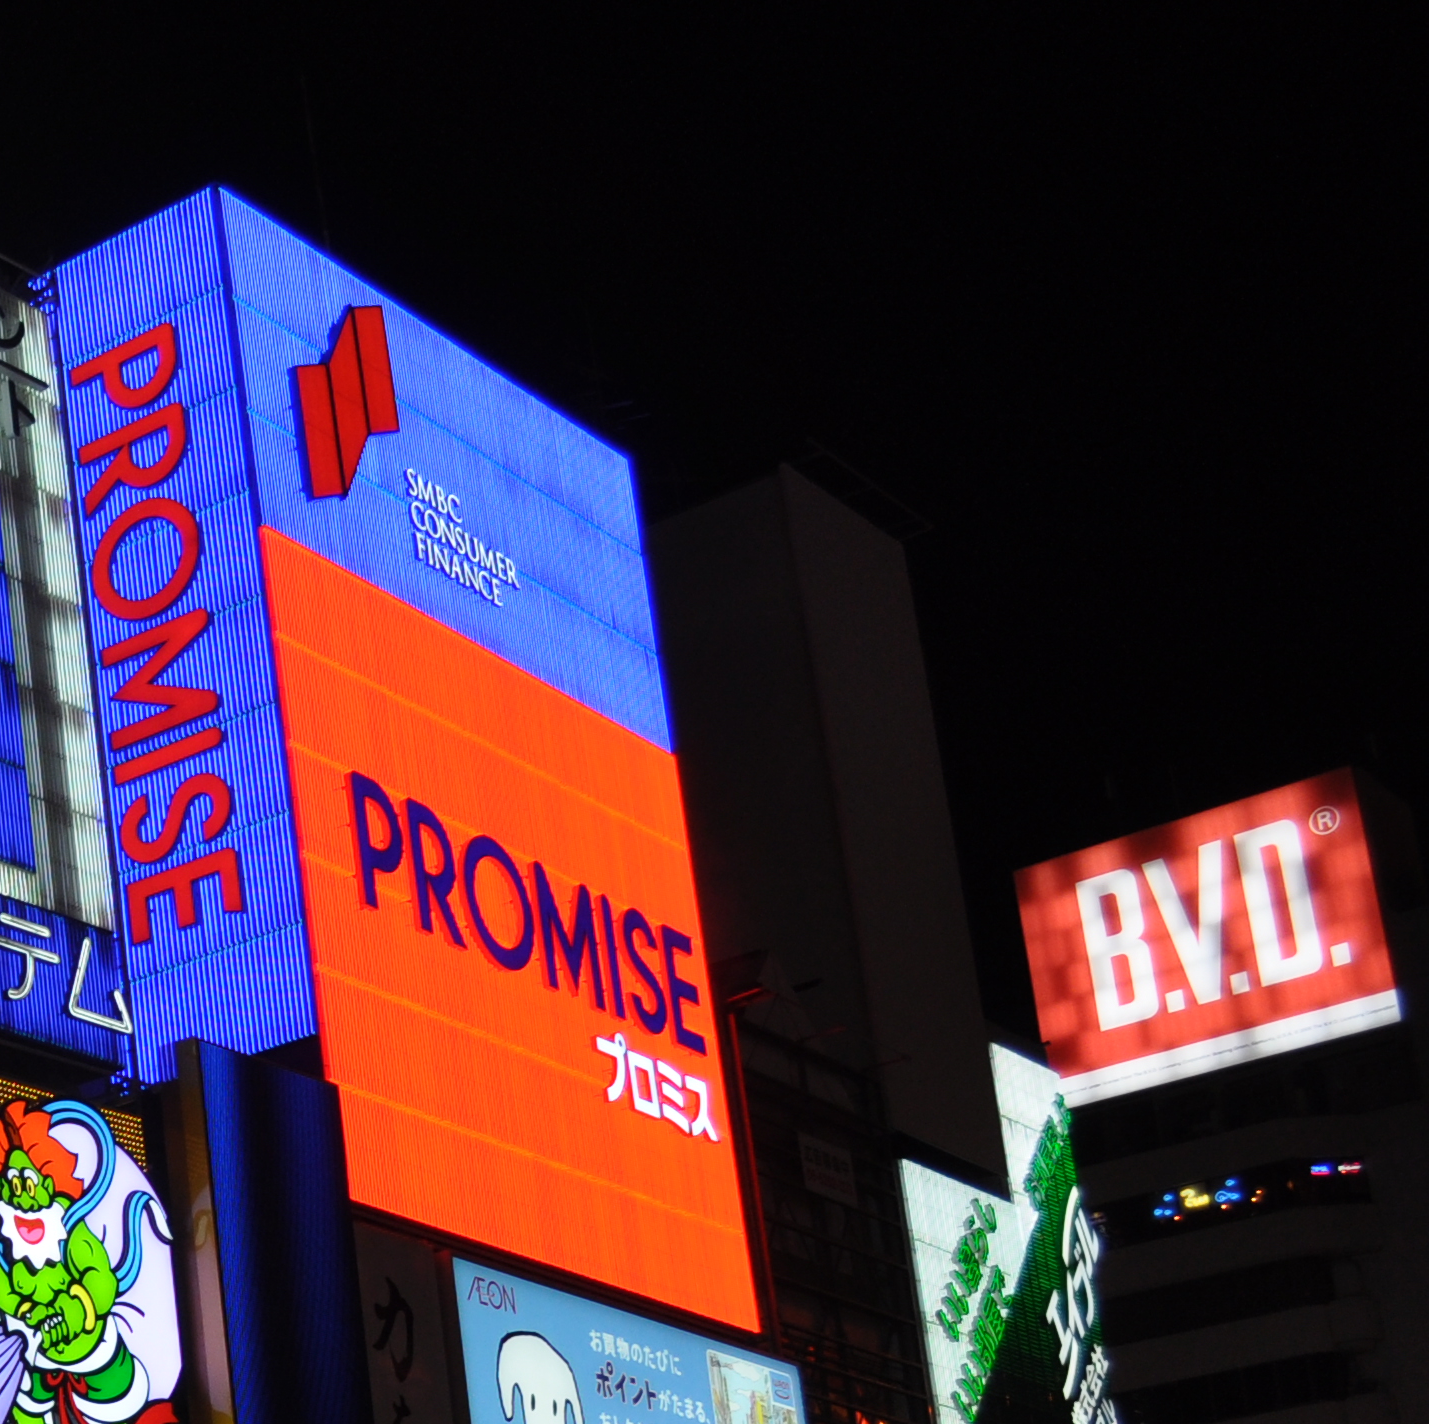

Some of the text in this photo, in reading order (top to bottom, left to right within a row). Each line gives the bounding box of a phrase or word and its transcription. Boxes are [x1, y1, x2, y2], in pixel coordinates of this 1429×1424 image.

[406, 467, 461, 525] SMBC
[410, 500, 521, 591] CONSUMER
[414, 532, 504, 608] FINANCE
[70, 321, 245, 944] PROMISE
[347, 770, 707, 1056] PROMISE
[1074, 819, 1352, 1032] B.V.D.
[594, 1032, 721, 1142] プロミス
[1046, 1205, 1100, 1372] エイブル
[589, 1329, 682, 1376] お買物のたびに
